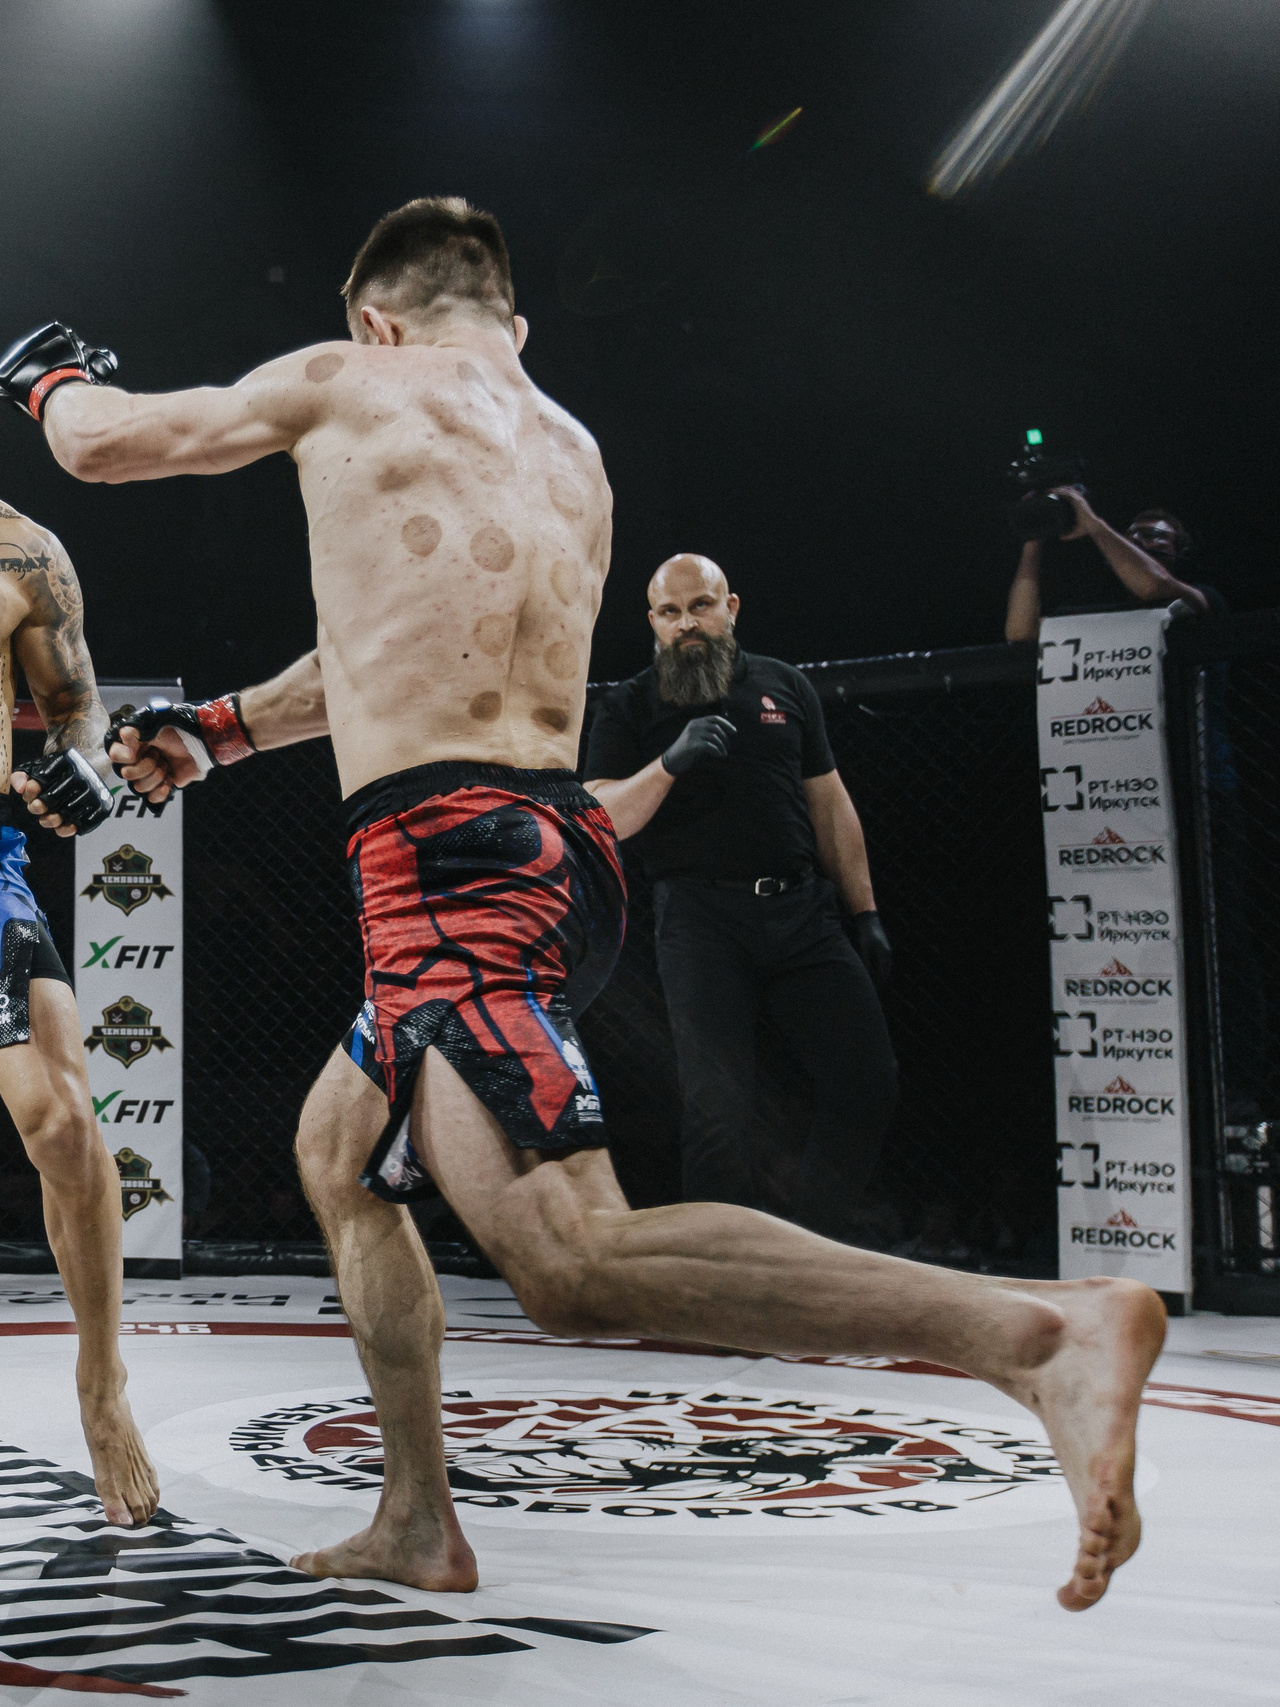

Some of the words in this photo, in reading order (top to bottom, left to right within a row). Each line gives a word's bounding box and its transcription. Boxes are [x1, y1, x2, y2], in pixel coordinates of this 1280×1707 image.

[1084, 646, 1152, 663] РТ-НЭО
[1083, 664, 1152, 682] Иркутск
[1050, 713, 1153, 738] REDROCK
[1088, 777, 1158, 793] РТ-НЭО
[1089, 795, 1161, 812] Иркутск
[1058, 845, 1167, 866] REDROCK
[1065, 979, 1173, 998] REDROCK
[1103, 1028, 1173, 1044] РТ-НЭО
[1103, 1045, 1174, 1061] Иркутск
[1068, 1096, 1175, 1115] REDROCK
[1105, 1160, 1176, 1177] РТ-НЭО
[1106, 1177, 1176, 1195] Иркутск
[1071, 1227, 1176, 1250] REDROCK
